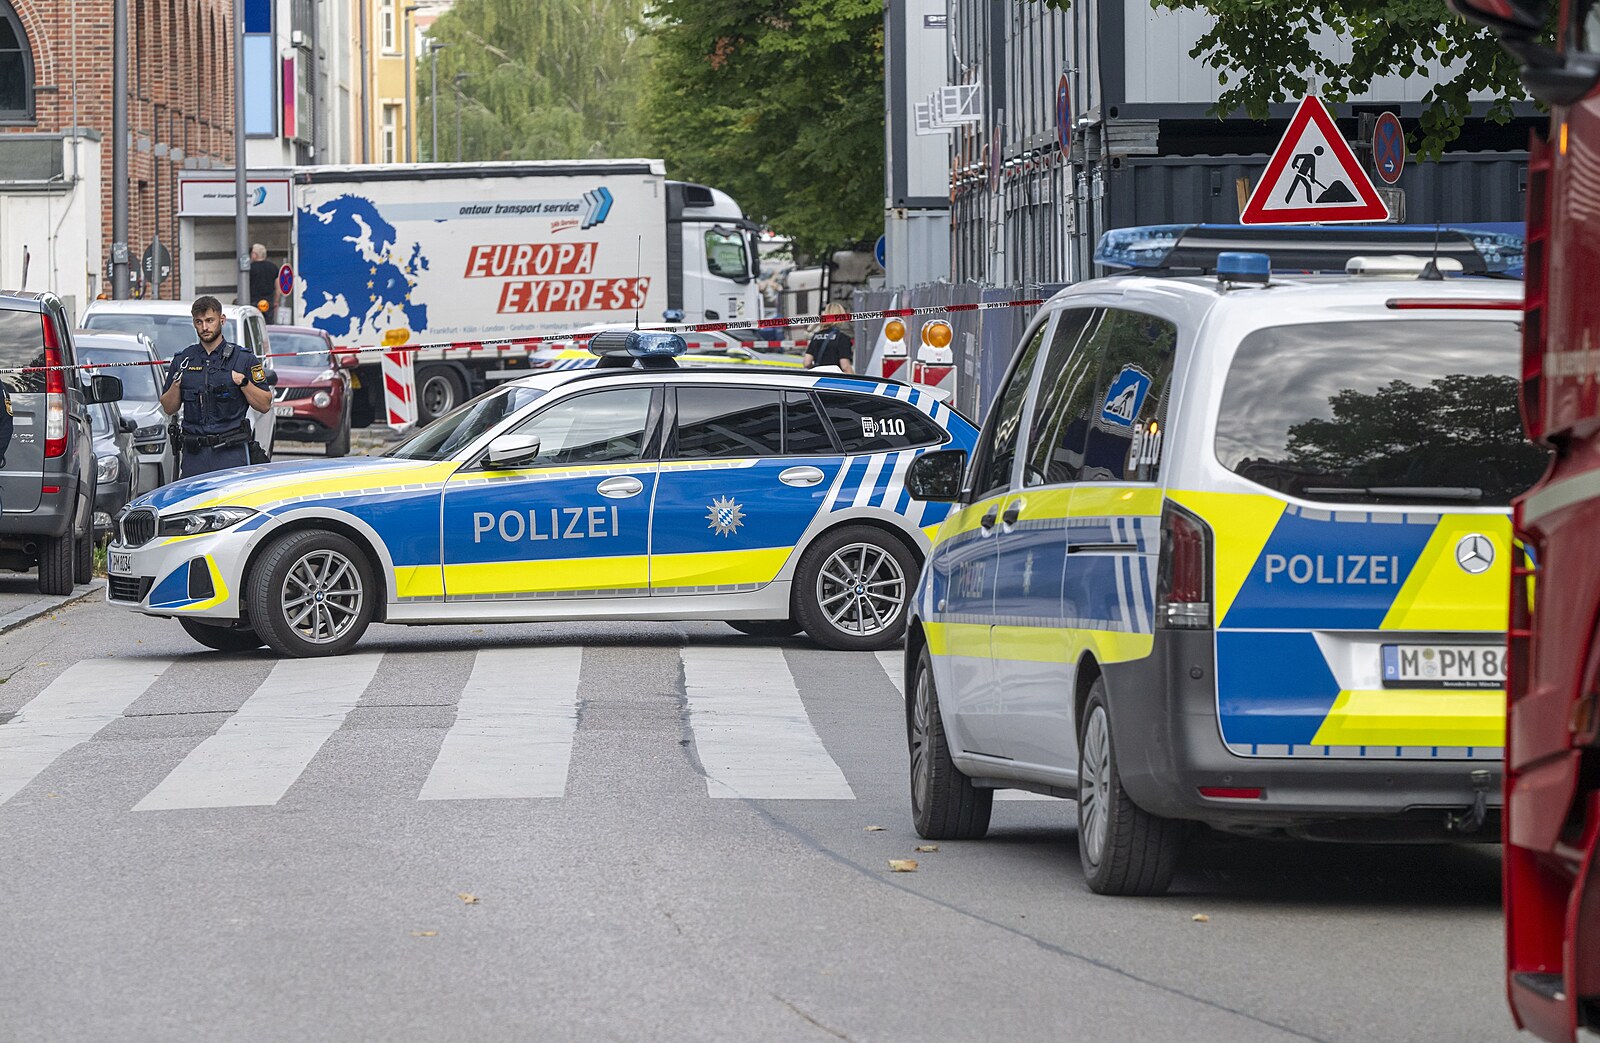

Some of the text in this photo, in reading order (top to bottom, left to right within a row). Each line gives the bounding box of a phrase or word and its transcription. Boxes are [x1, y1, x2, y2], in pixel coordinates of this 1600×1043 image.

[459, 202, 580, 215] ontour transport service
[469, 243, 593, 277] EUROPA
[501, 278, 648, 312] EXPRESS
[482, 324, 505, 332] London
[880, 418, 906, 436] 110
[1140, 430, 1161, 465] 110
[473, 505, 619, 543] POLIZEI
[1265, 554, 1398, 584] POLIZEI
[1401, 649, 1419, 676] M
[1439, 649, 1475, 677] PM
